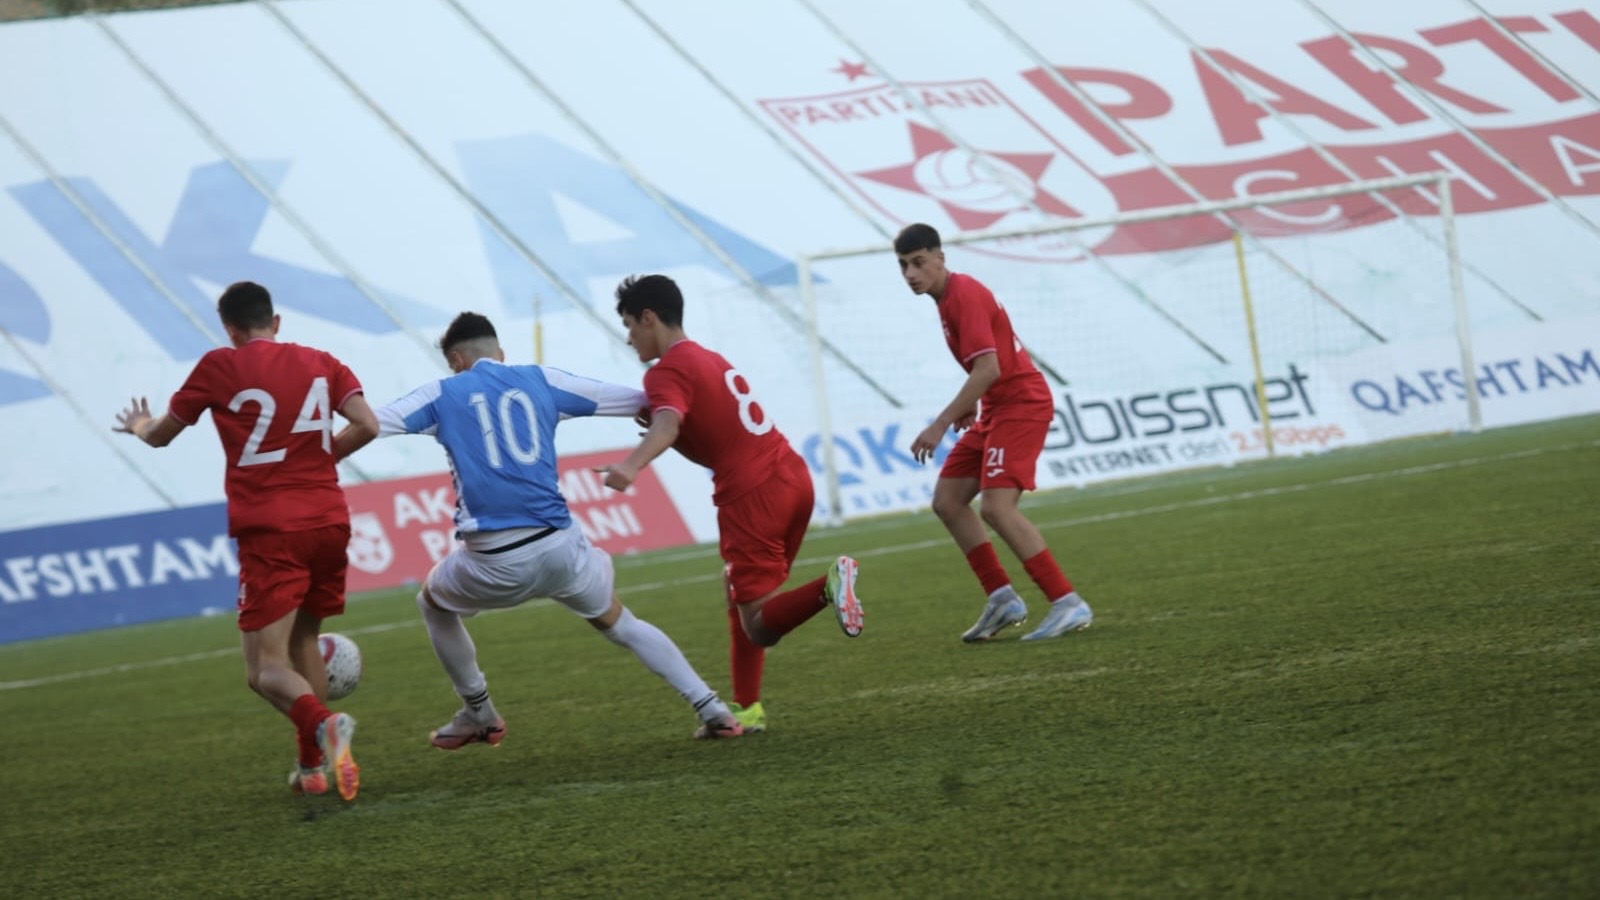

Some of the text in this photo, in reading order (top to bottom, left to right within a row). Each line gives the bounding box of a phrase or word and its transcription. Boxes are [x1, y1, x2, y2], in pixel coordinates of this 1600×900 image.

[228, 377, 332, 467] 24
[470, 388, 539, 469] 10
[724, 368, 774, 435] 8
[986, 448, 1005, 466] 21
[1050, 443, 1175, 477] INTERNET
